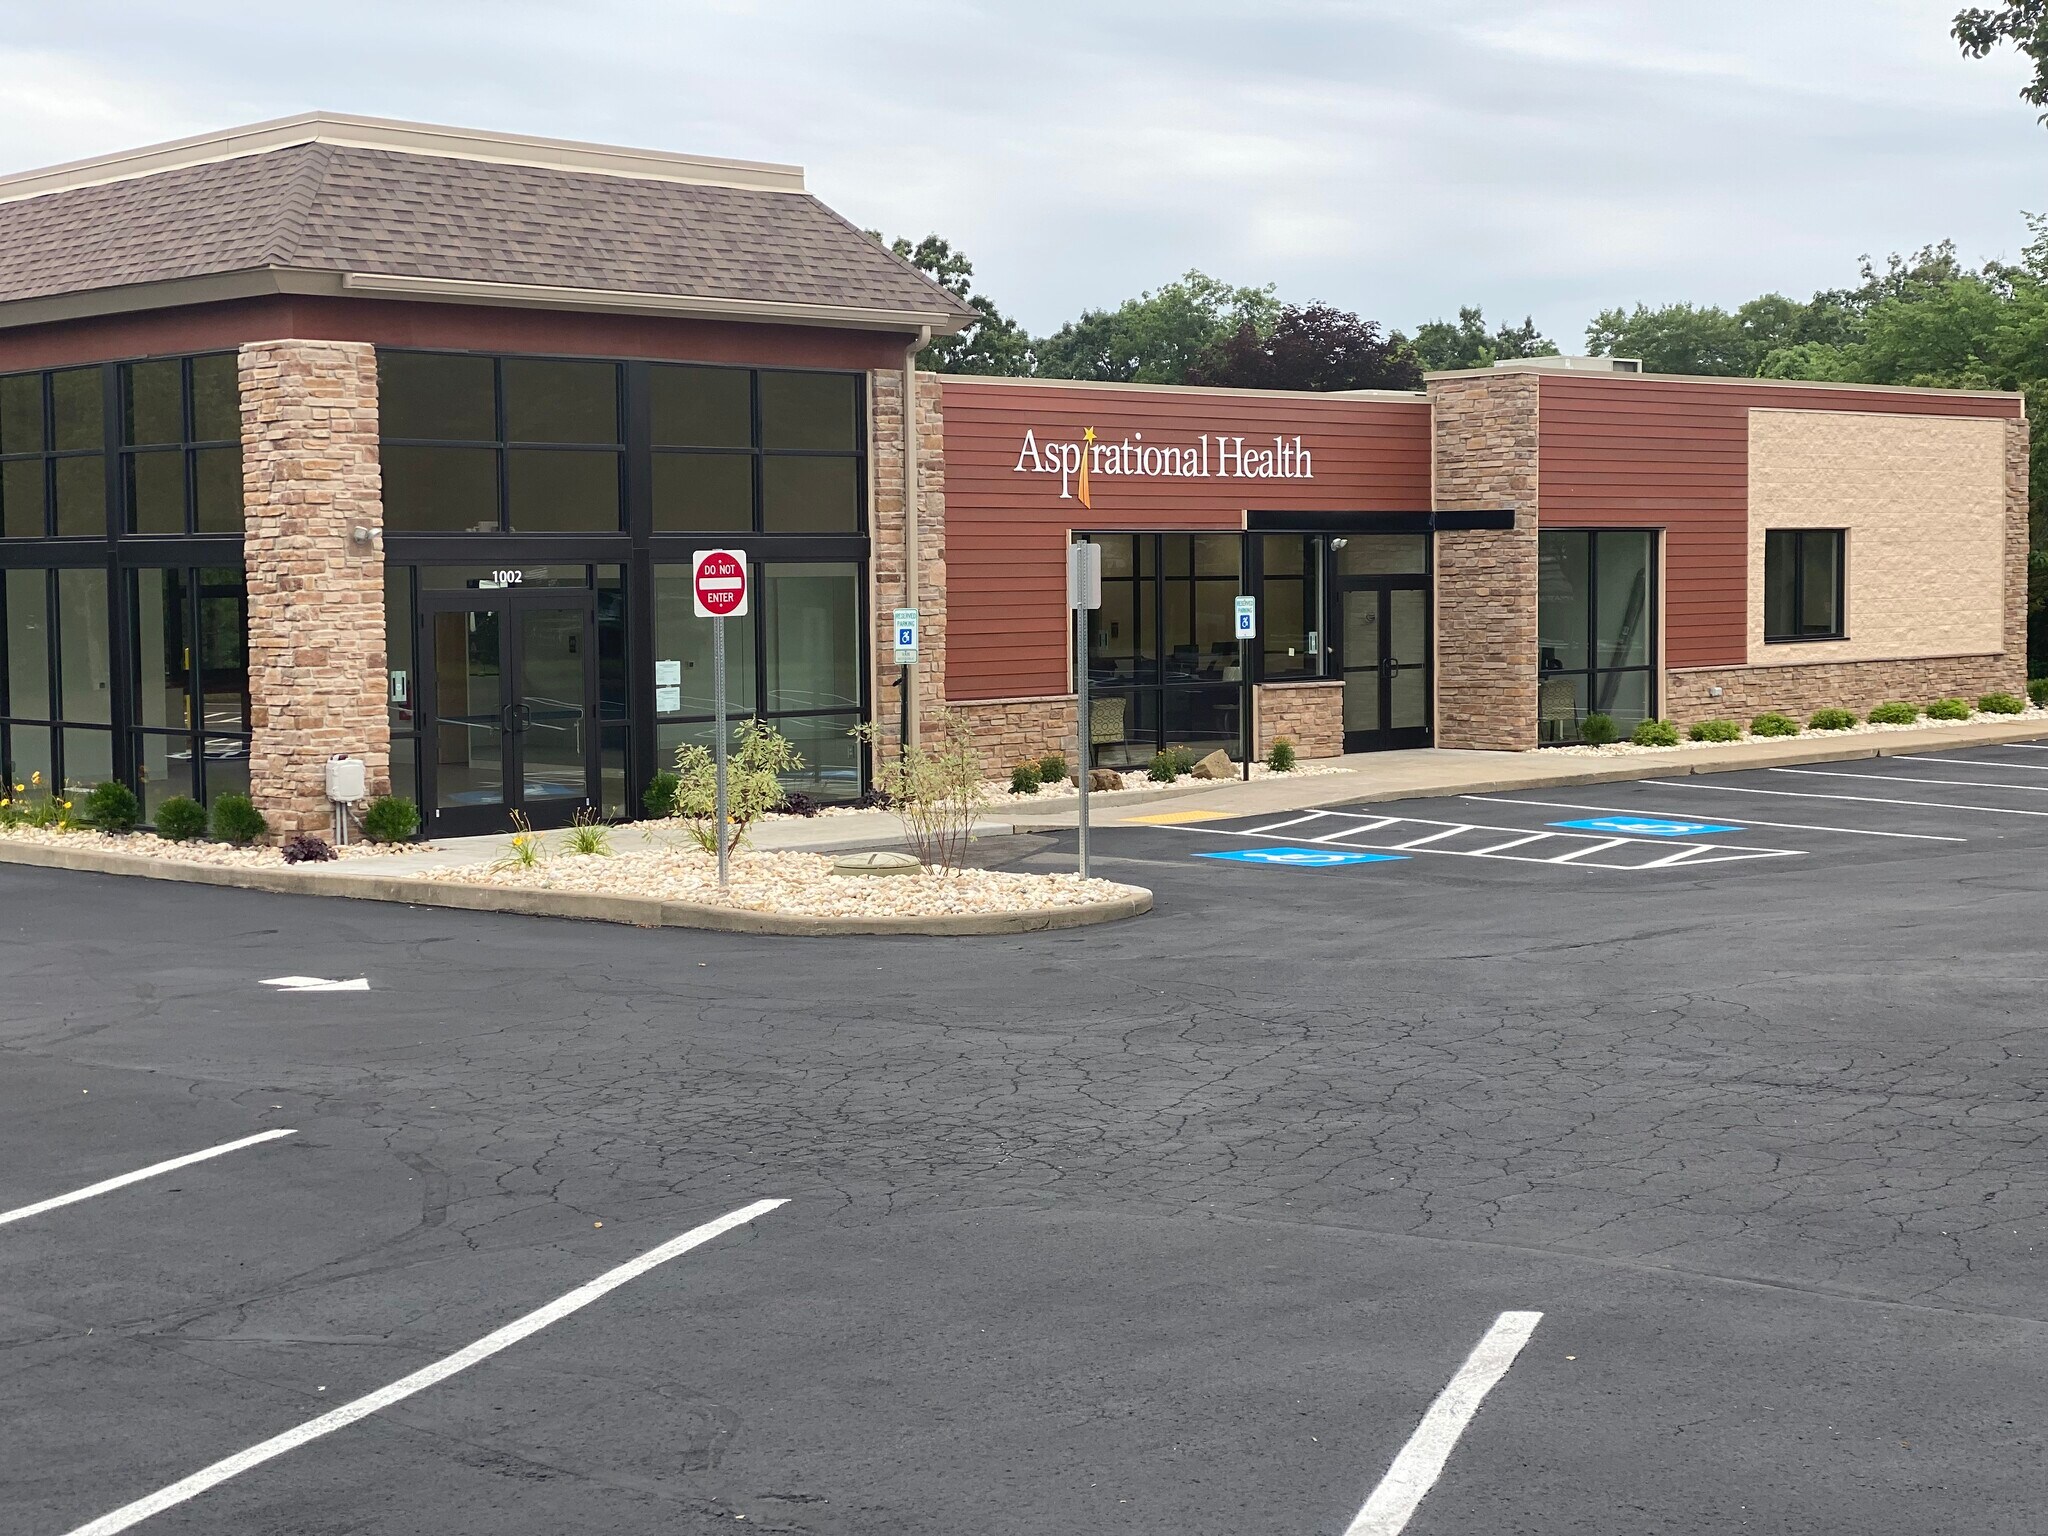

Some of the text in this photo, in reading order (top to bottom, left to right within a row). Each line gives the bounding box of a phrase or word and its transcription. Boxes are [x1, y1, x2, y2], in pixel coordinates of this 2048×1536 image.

[1013, 426, 1314, 508] Aspirational Health
[704, 564, 735, 575] DO NOT
[492, 570, 522, 583] 1002
[707, 592, 734, 603] ENTER
